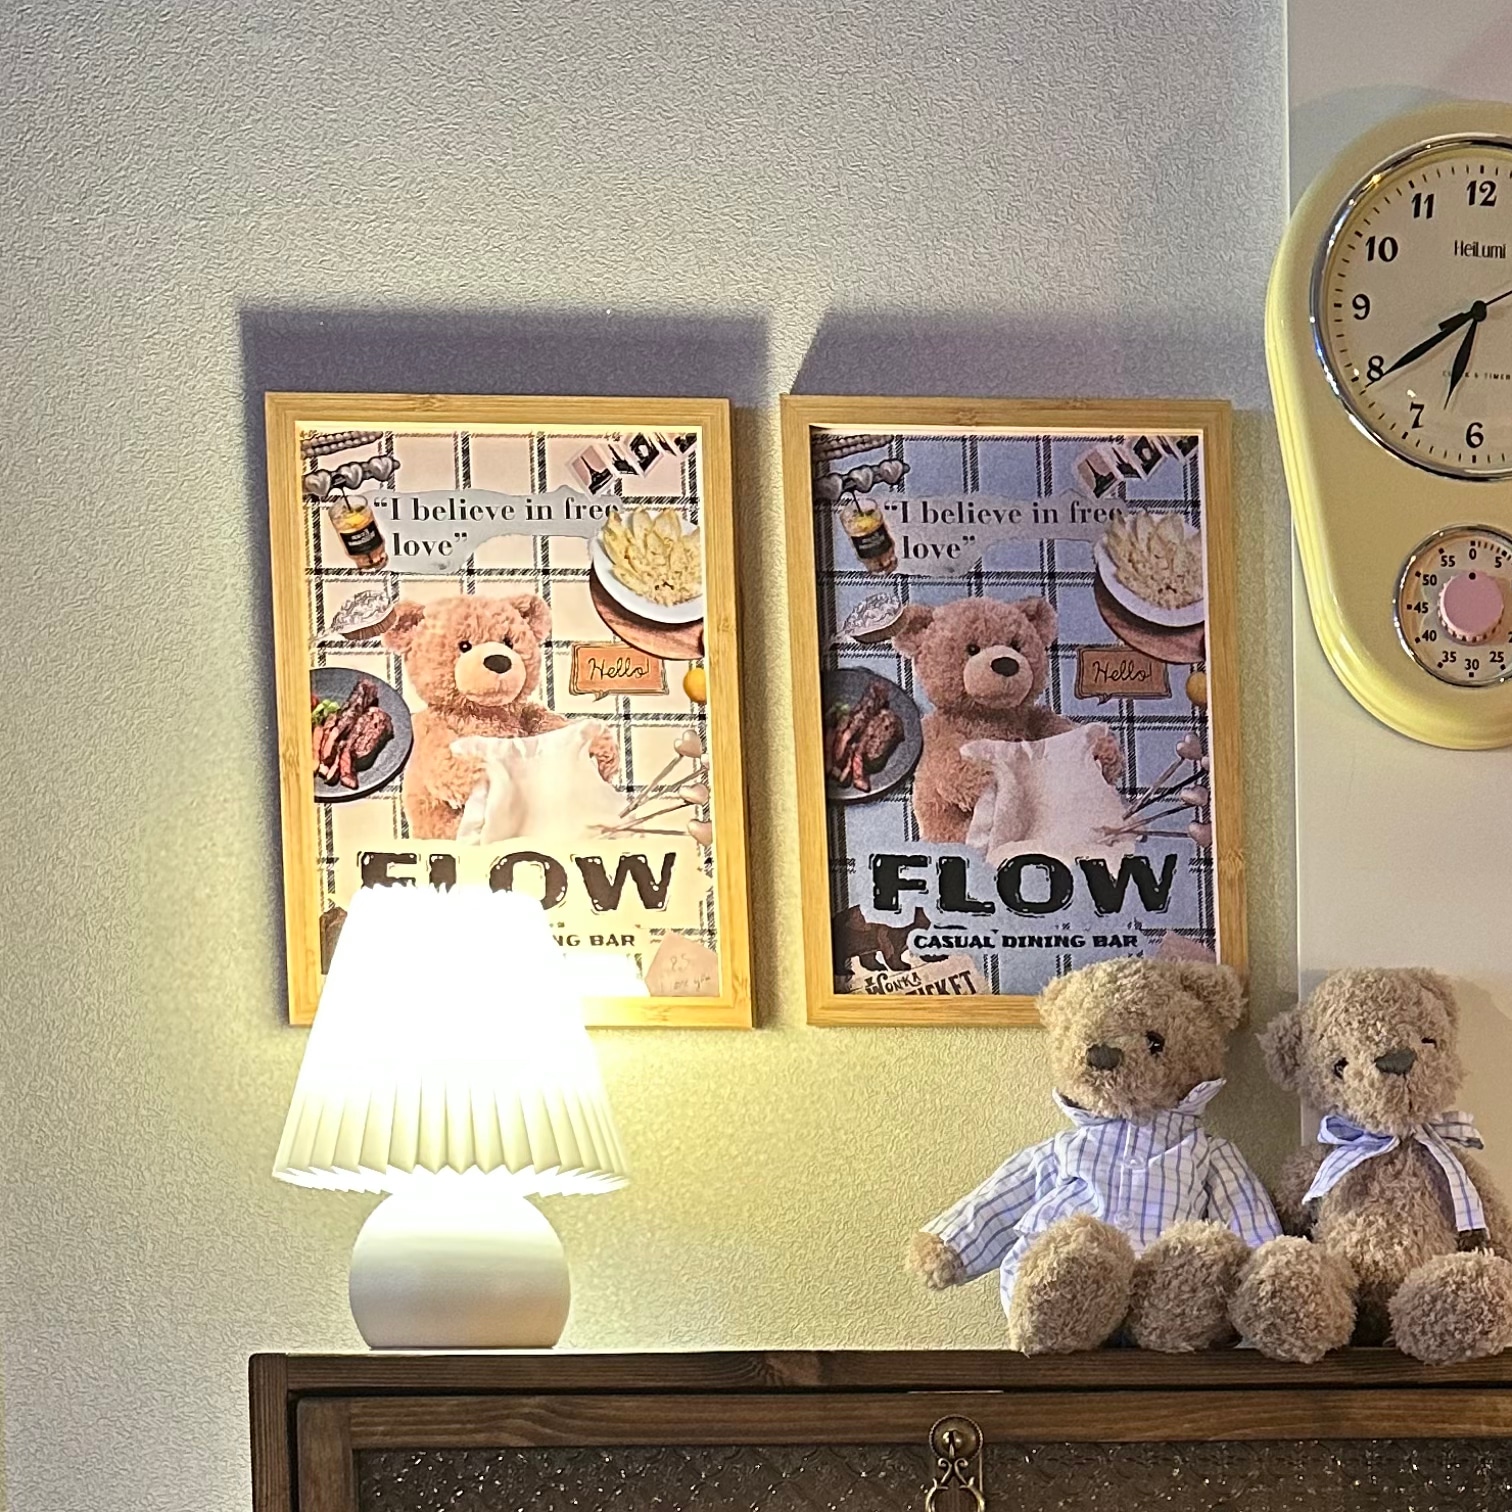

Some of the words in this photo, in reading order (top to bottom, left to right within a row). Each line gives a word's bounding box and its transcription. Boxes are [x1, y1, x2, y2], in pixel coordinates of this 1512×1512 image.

[1466, 180, 1497, 207] 12
[1411, 193, 1435, 219] 11
[1365, 236, 1399, 262] 10
[1352, 293, 1371, 320] 9
[1366, 356, 1386, 382] 8
[1409, 403, 1425, 429] 7
[1465, 422, 1484, 448] 6
[411, 498, 515, 521] believe
[525, 498, 554, 521] in
[921, 501, 1022, 524] believe
[1032, 502, 1059, 524] in
[1440, 555, 1456, 567] 55
[1469, 548, 1477, 560] 0
[1494, 556, 1502, 568] 5
[1422, 574, 1438, 586] 50
[1413, 602, 1429, 614] 45
[1421, 630, 1437, 642] 40
[1442, 651, 1457, 663] 35
[1464, 658, 1480, 670] 30
[1489, 651, 1504, 663] 25
[871, 854, 1177, 915] FLOW
[589, 934, 636, 947] BAR
[913, 935, 996, 949] CASUAL
[1001, 935, 1086, 949] DINING
[1092, 935, 1138, 949] BAR
